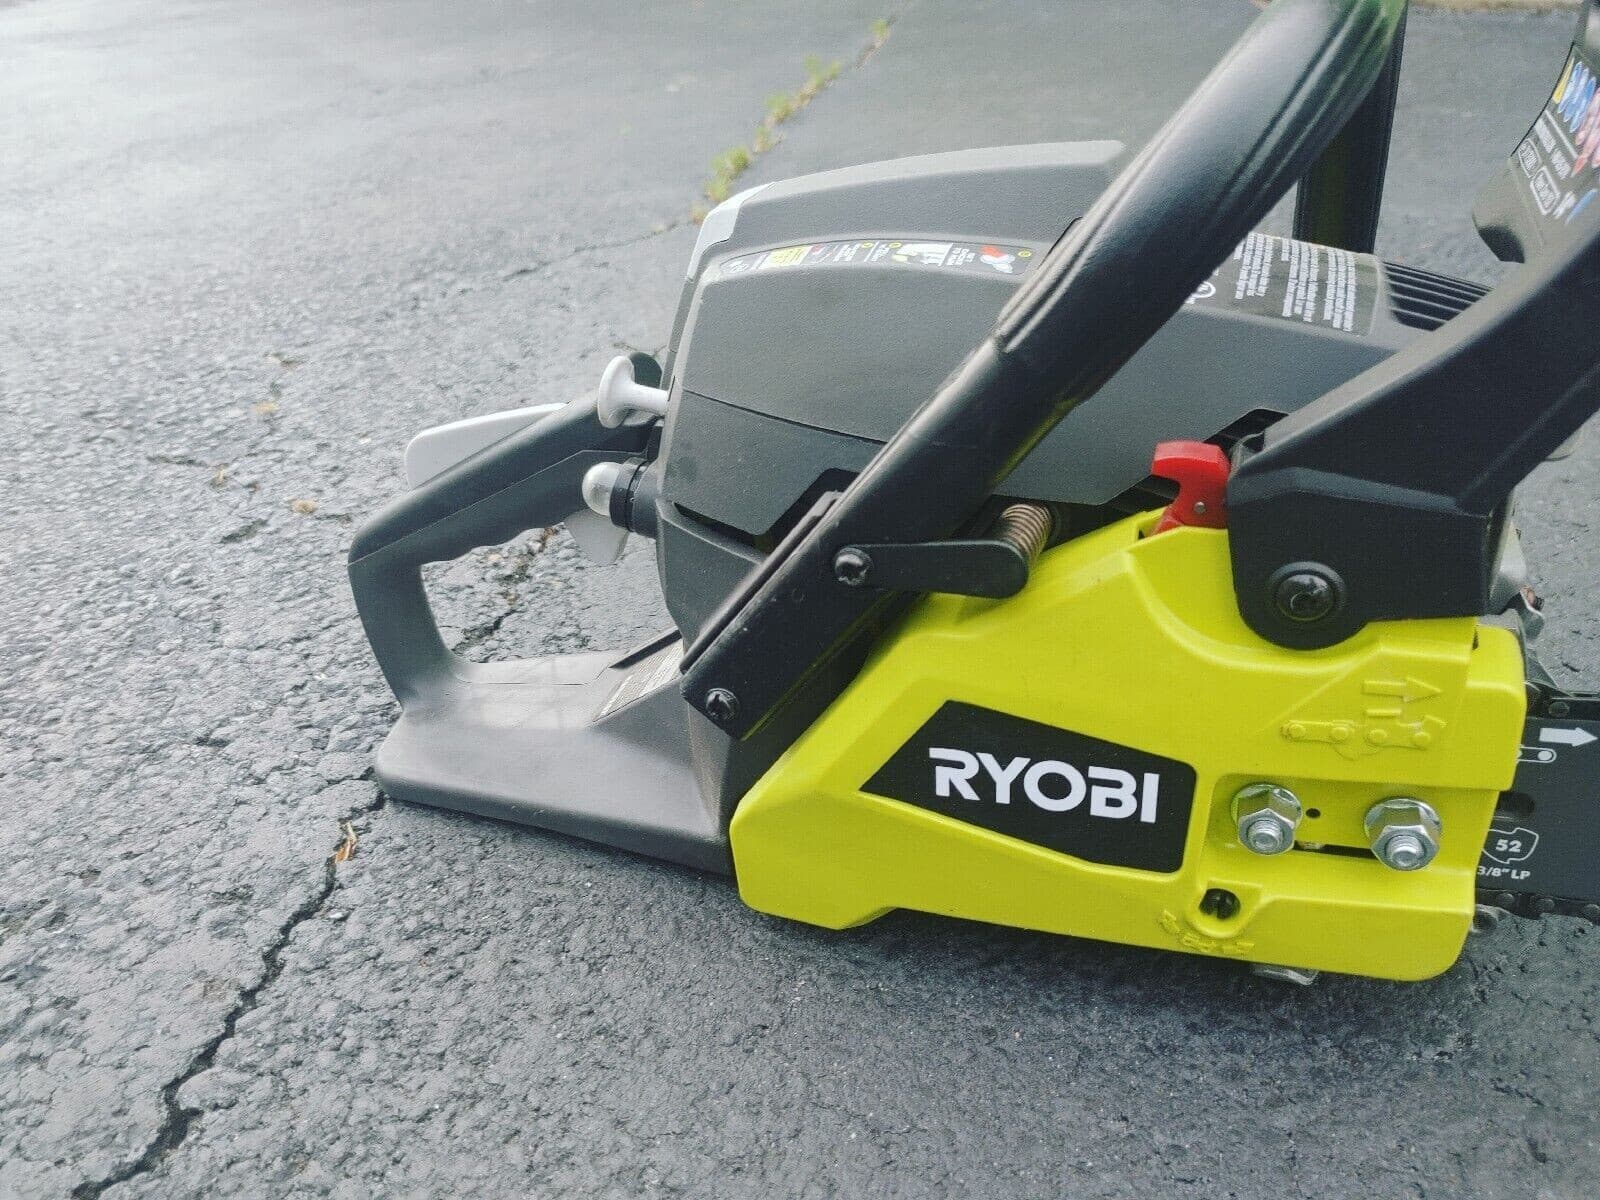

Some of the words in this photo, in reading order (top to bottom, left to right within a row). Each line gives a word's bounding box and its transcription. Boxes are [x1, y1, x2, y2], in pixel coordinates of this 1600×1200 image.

[929, 747, 1160, 824] RYOBI
[1495, 839, 1522, 853] 52
[1511, 870, 1531, 880] LP
